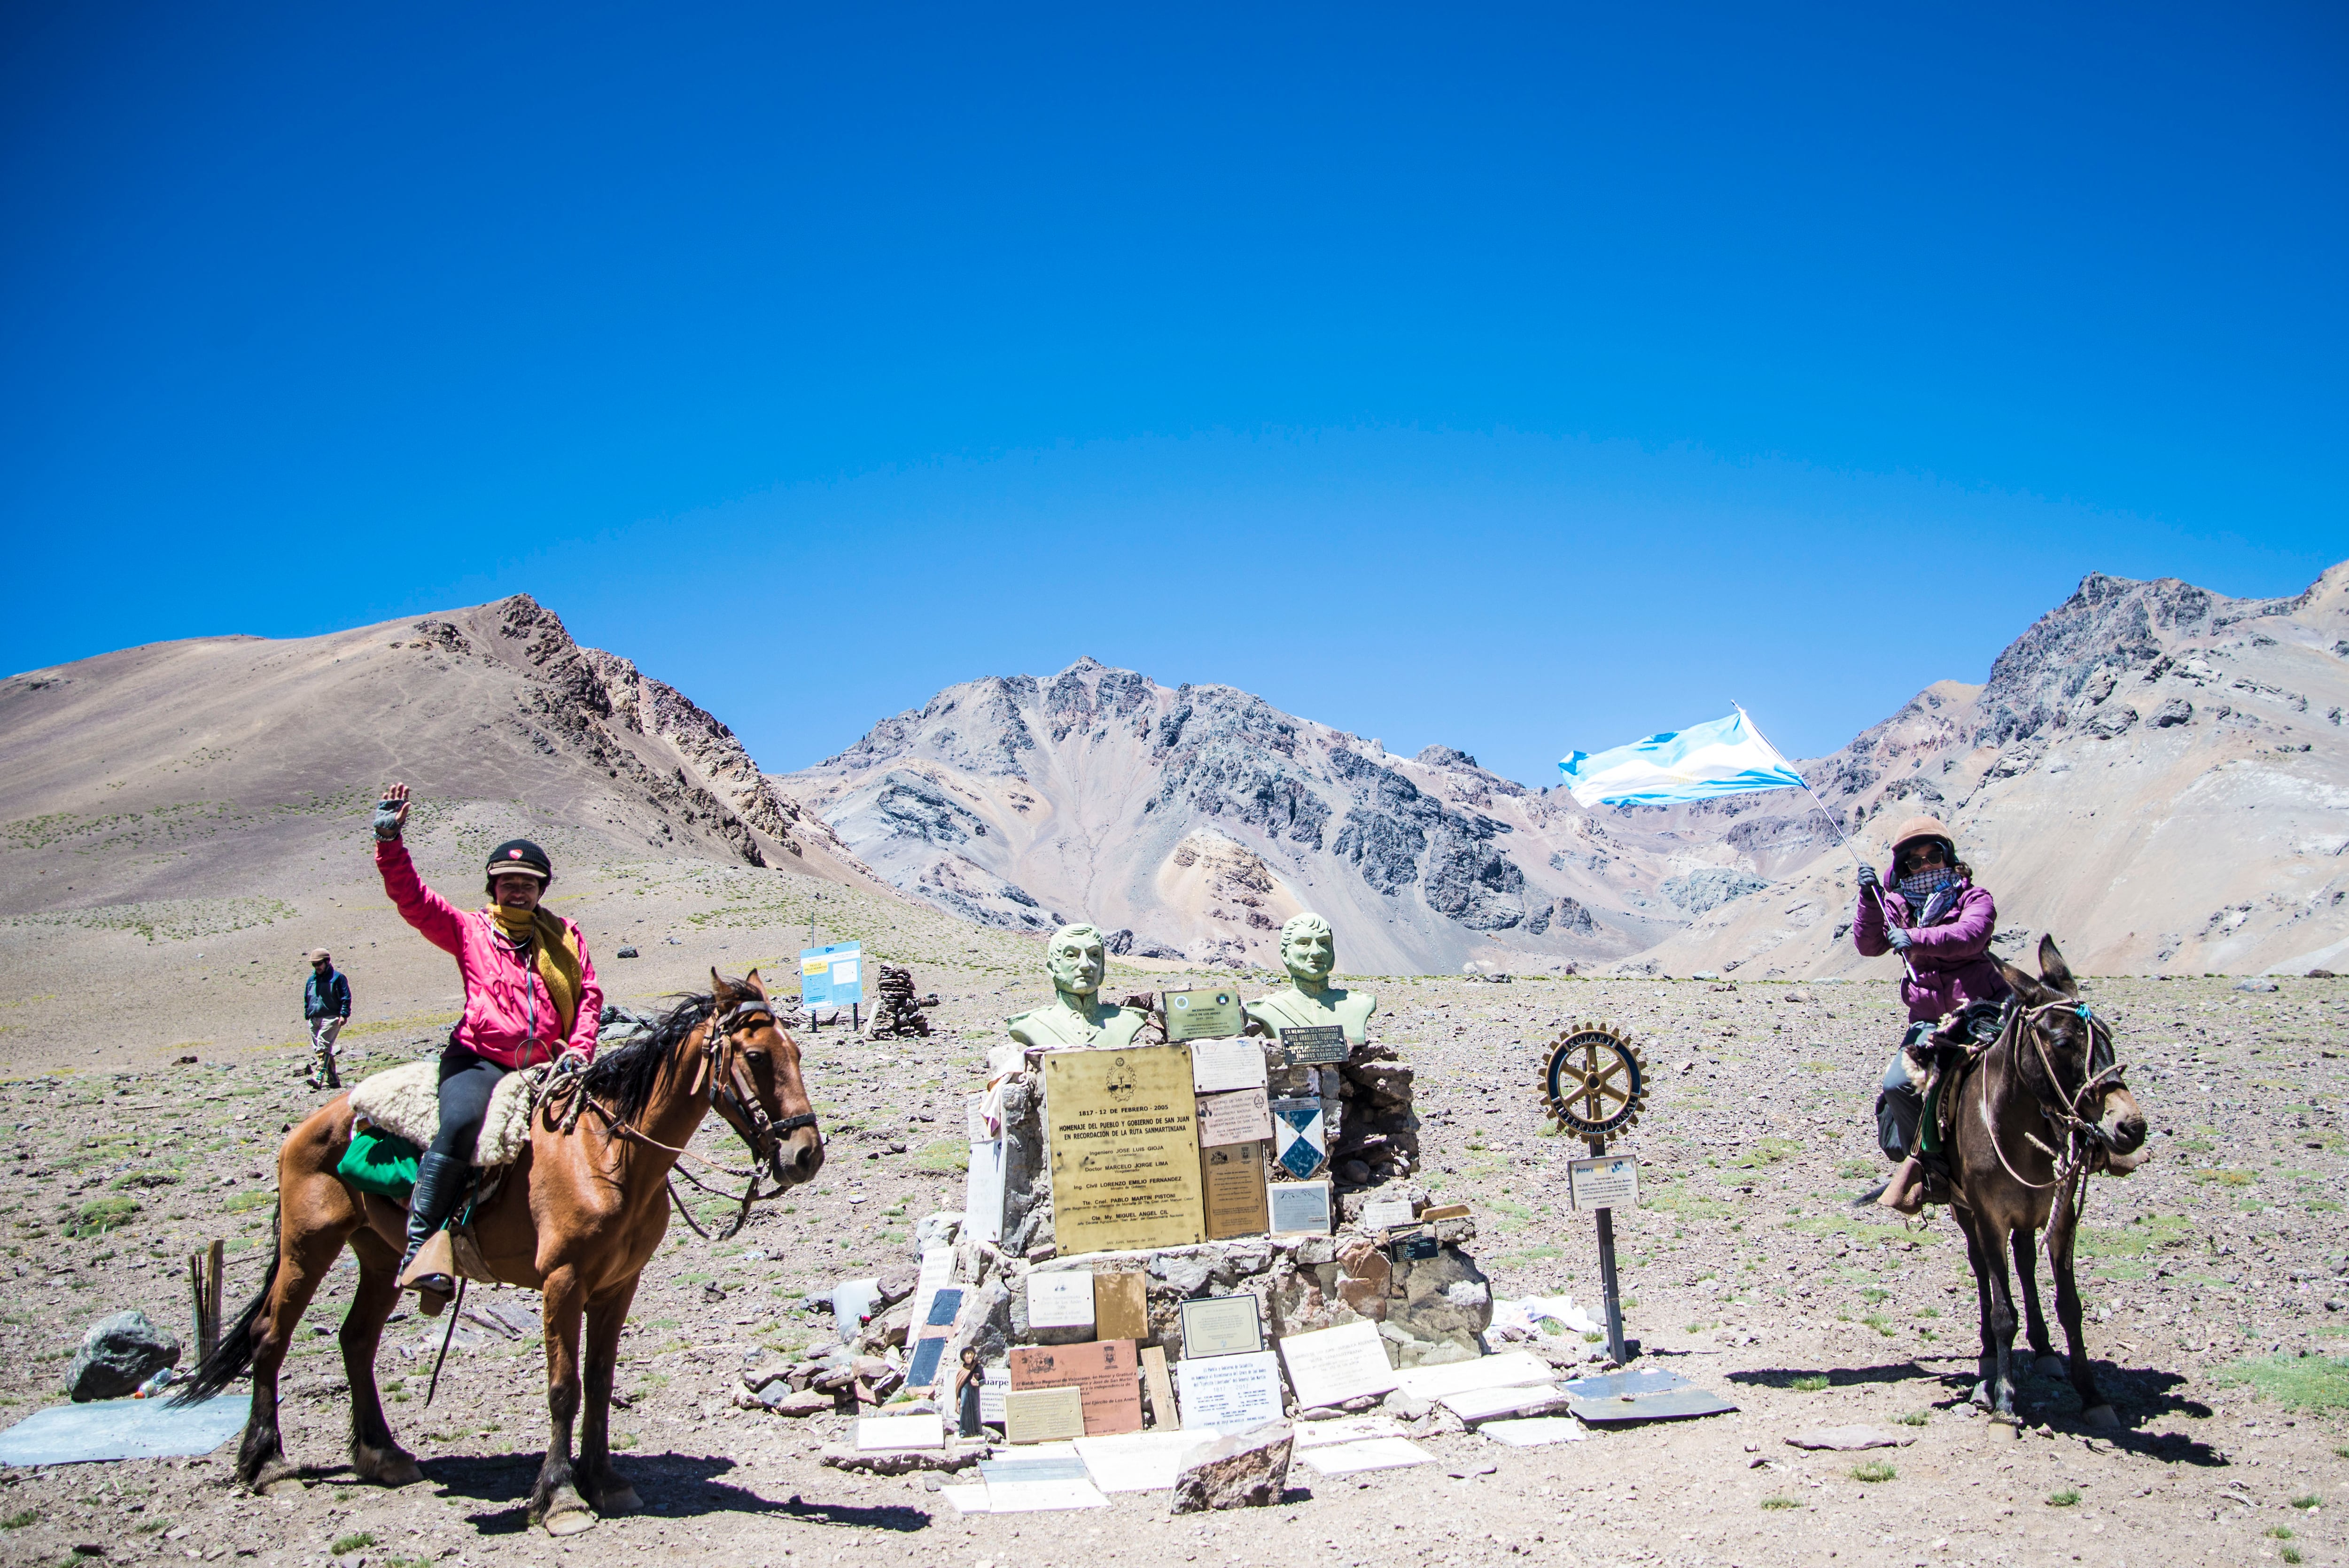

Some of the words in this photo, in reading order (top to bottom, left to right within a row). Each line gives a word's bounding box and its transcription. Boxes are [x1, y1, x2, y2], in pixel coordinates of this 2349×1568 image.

[1569, 1034, 1614, 1048] ROTARY
[1555, 1098, 1638, 1132] INTERNATIONAL
[1073, 1131, 1110, 1140] RECORDACION
[1145, 1125, 1187, 1134] SANMARTINIANA
[986, 1380, 1009, 1389] uarpe
